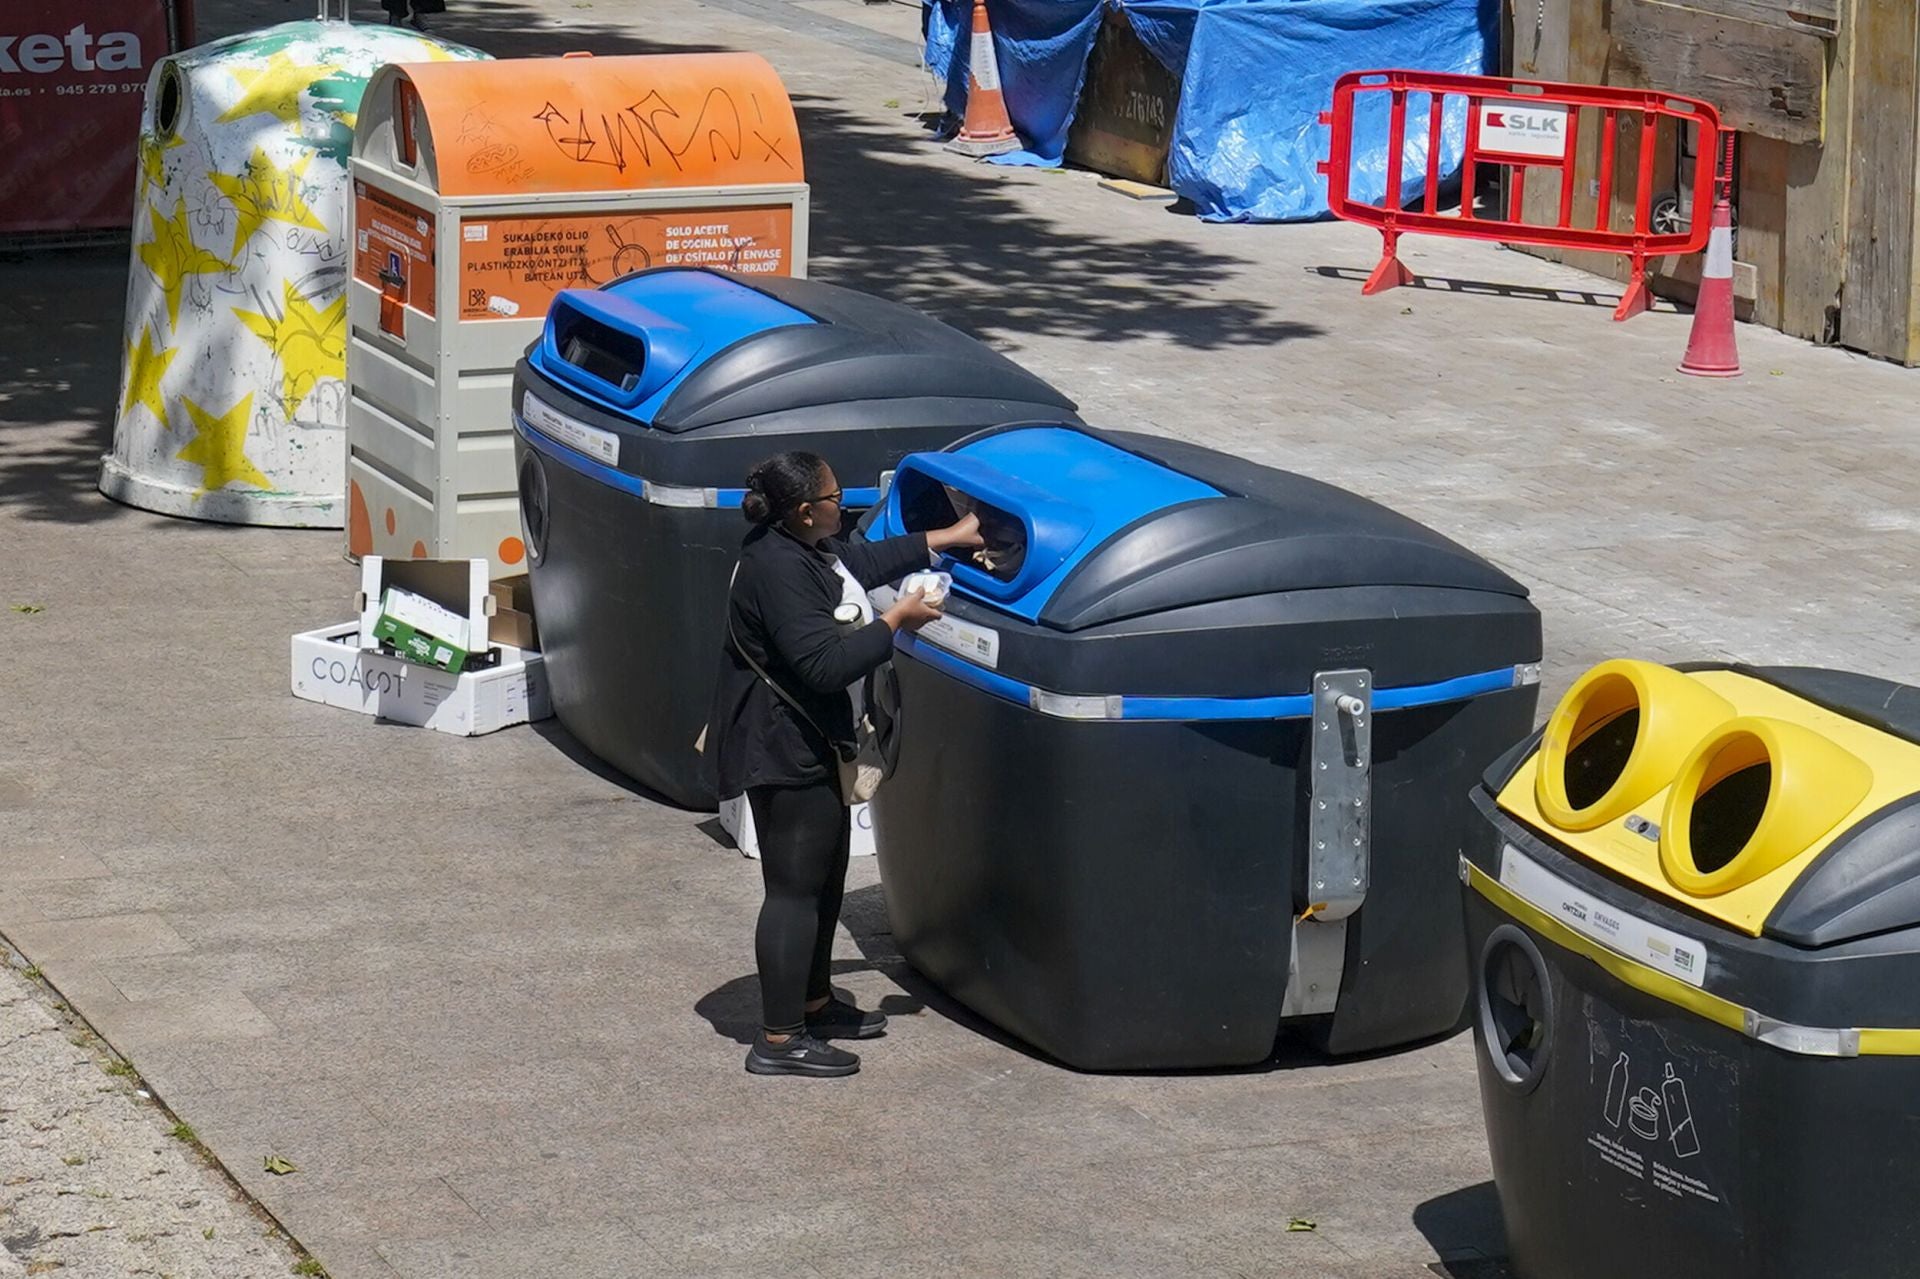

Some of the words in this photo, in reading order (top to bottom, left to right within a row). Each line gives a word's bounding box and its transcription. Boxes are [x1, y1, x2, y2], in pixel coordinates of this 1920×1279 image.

[56, 85, 84, 95] 945
[89, 84, 117, 94] 279
[1509, 114, 1559, 132] SLK
[666, 226, 692, 237] SOLO
[694, 225, 729, 235] ACEITE
[503, 231, 563, 243] SUKALDEKO
[566, 231, 589, 240] OLIO
[666, 239, 679, 250] DE
[681, 239, 718, 249] COCINA
[744, 249, 782, 260] ENVASE
[524, 273, 564, 282] BATEAN
